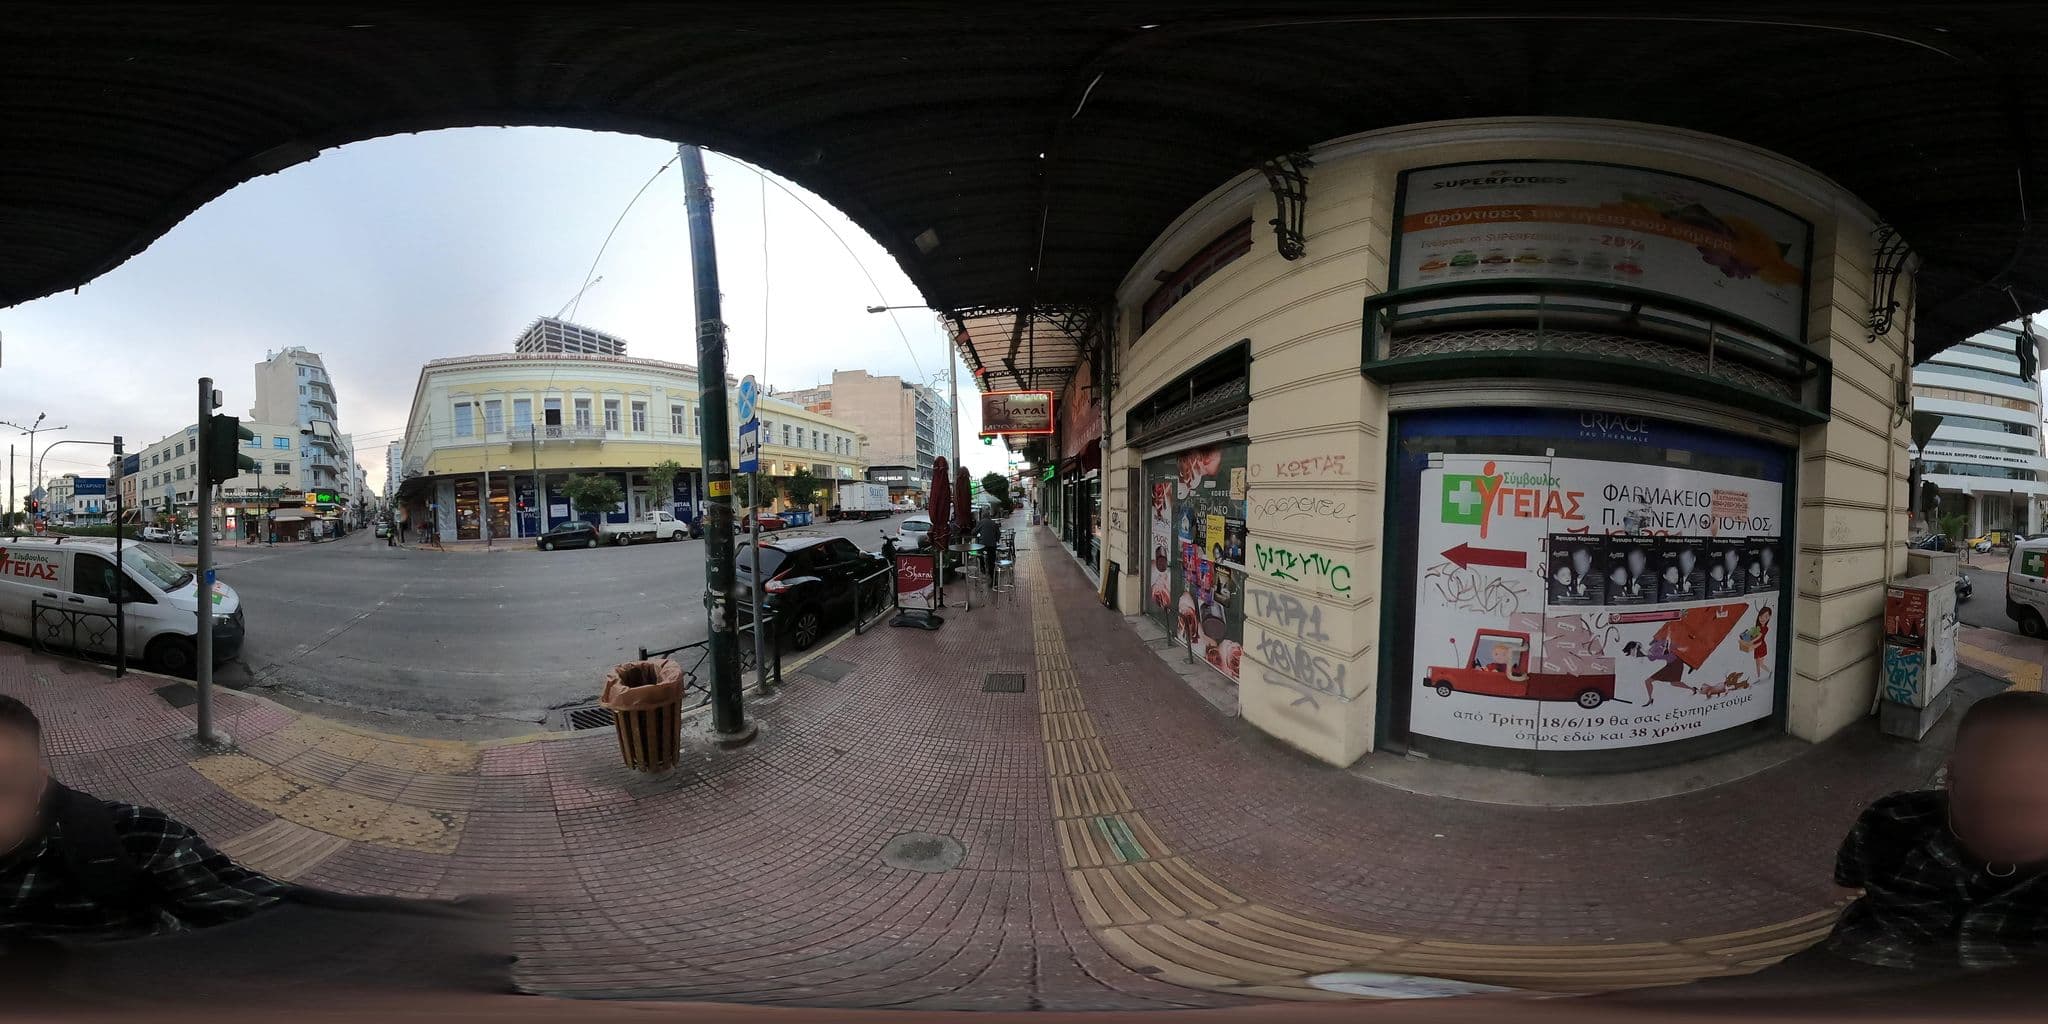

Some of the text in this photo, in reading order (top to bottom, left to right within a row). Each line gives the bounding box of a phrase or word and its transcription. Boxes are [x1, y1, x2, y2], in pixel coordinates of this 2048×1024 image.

[1432, 176, 1569, 190] SUPERFOODS
[1580, 413, 1649, 434] URIAGE
[1908, 449, 1953, 457] MEDERRANEAN
[1954, 452, 1977, 460] SHIPPING
[1978, 454, 2002, 462] COMPANY
[1503, 472, 1561, 489] Σύμβουλος
[1603, 484, 1711, 508] ΦΑΡΜΑΚΕΙΟ
[1638, 510, 1770, 532] ΝΕΛΛΟΠΟΥΛΟΣ
[1454, 693, 1754, 729] από Τρίτη 18/6/19 θα σας εξυπηρετούμε
[1515, 720, 1702, 744] όπως εδώ και 38 χρόνια
